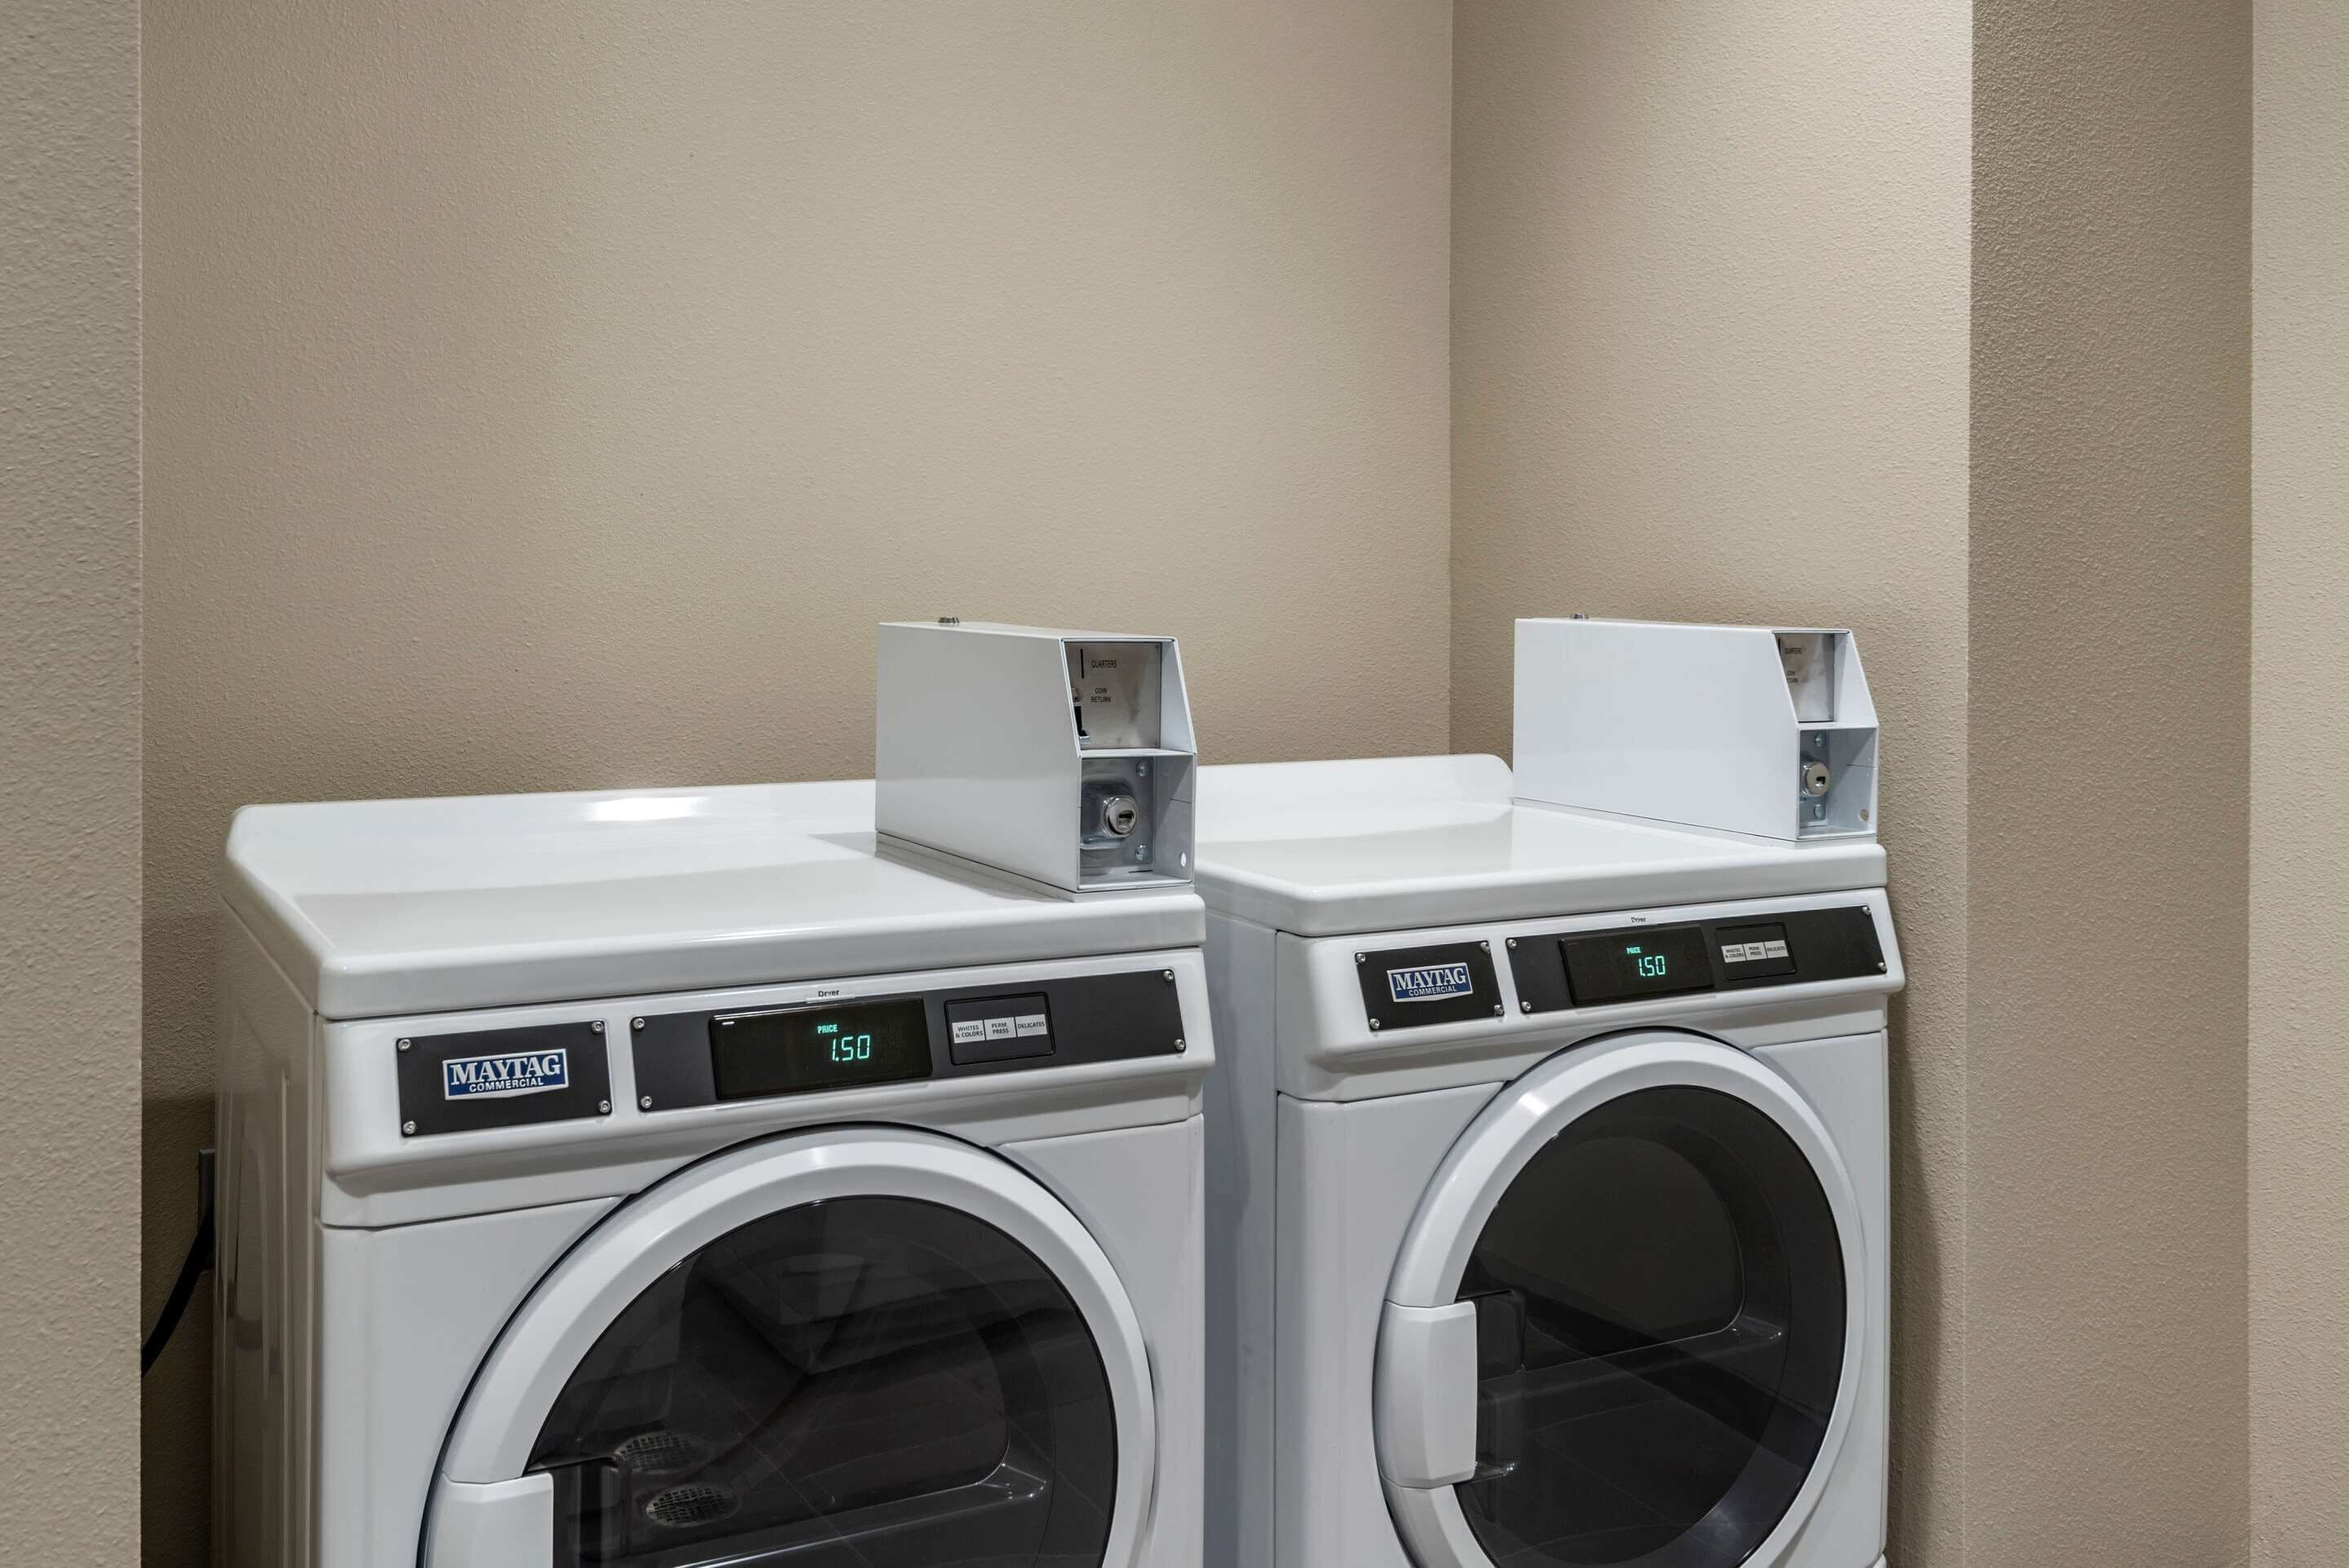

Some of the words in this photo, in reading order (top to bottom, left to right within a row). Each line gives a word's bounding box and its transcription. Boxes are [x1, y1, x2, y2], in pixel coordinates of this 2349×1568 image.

[1639, 956, 1666, 977] 1.50
[1393, 968, 1466, 991] MAYTAG
[1409, 985, 1457, 996] COMMERCIAL
[817, 1024, 838, 1034] PRICE
[832, 1035, 870, 1062] 1.50
[450, 1054, 561, 1085] MAYTAG
[469, 1076, 544, 1093] COMMERCIAL
